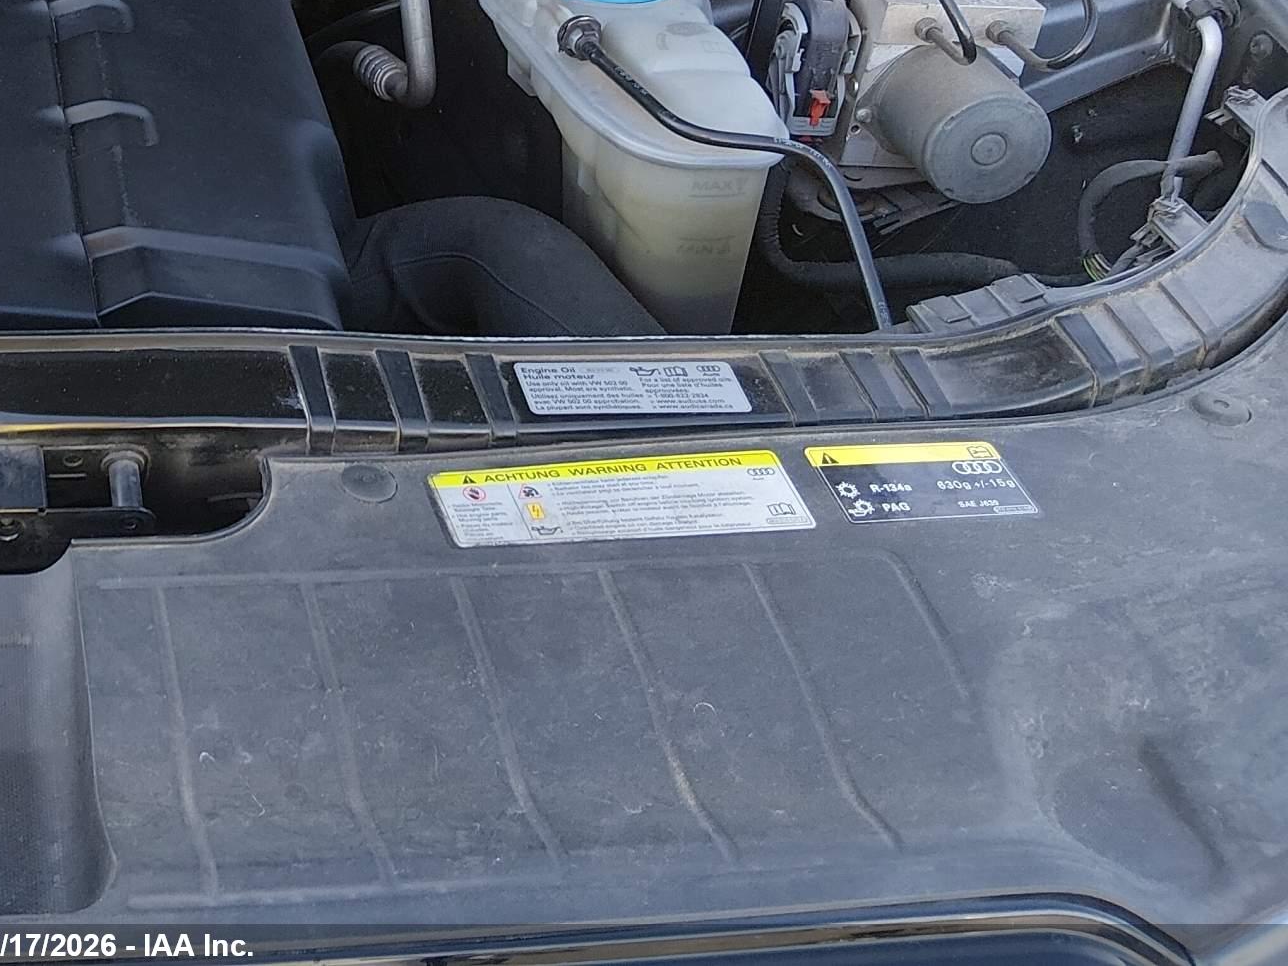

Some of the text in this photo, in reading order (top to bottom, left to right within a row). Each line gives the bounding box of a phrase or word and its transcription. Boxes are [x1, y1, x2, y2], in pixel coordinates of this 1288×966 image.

[520, 366, 558, 375] Engine
[484, 470, 561, 482] ACHTUNG
[568, 463, 648, 476] WARNING
[656, 457, 742, 470] ATTENTION
[870, 484, 913, 493] R-134a
[883, 502, 911, 512] PAG
